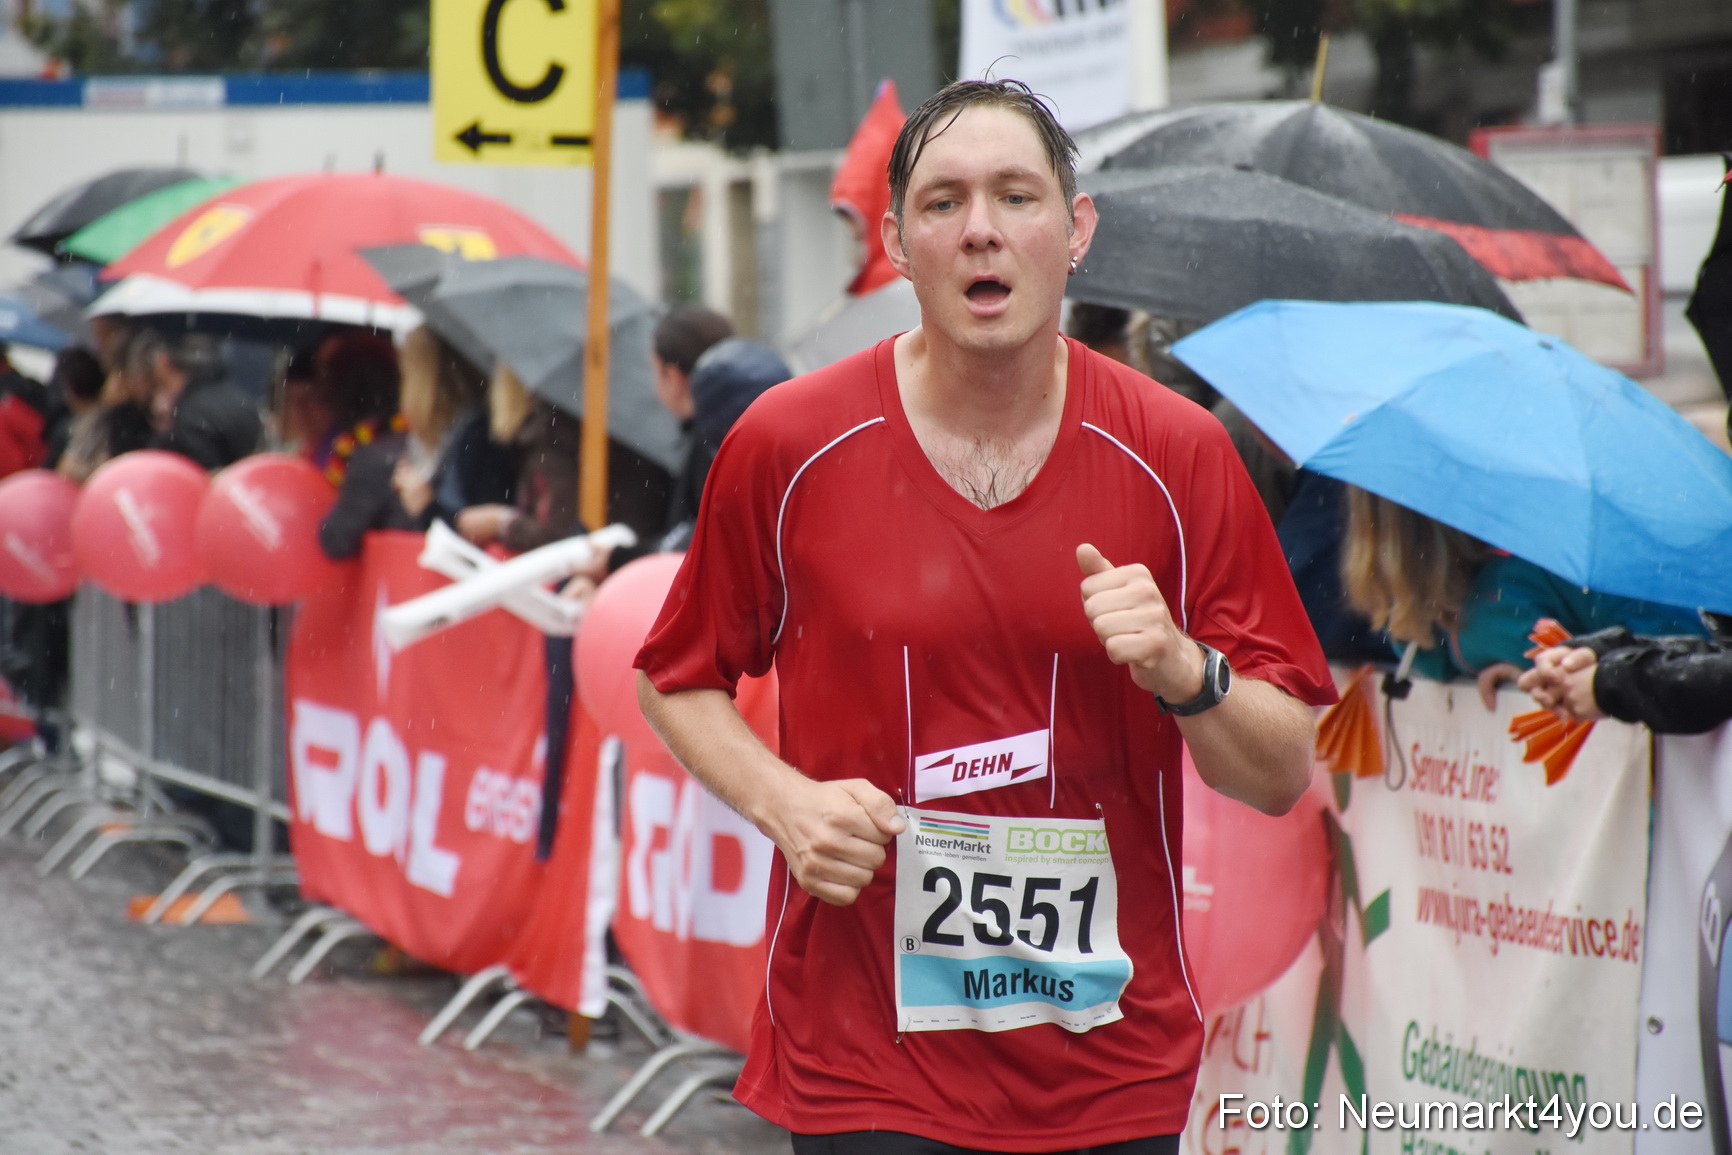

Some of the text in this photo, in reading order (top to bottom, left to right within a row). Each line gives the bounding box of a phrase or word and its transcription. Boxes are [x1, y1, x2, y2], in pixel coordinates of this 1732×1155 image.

[482, 0, 564, 104] C
[952, 751, 1014, 783] DEHN
[915, 834, 992, 855] NeuerMarkt
[1006, 826, 1110, 855] BOCK
[1005, 854, 1110, 865] inspired by smart concepts
[921, 866, 1100, 955] 2551
[905, 938, 915, 952] B
[963, 968, 1075, 1003] Markus
